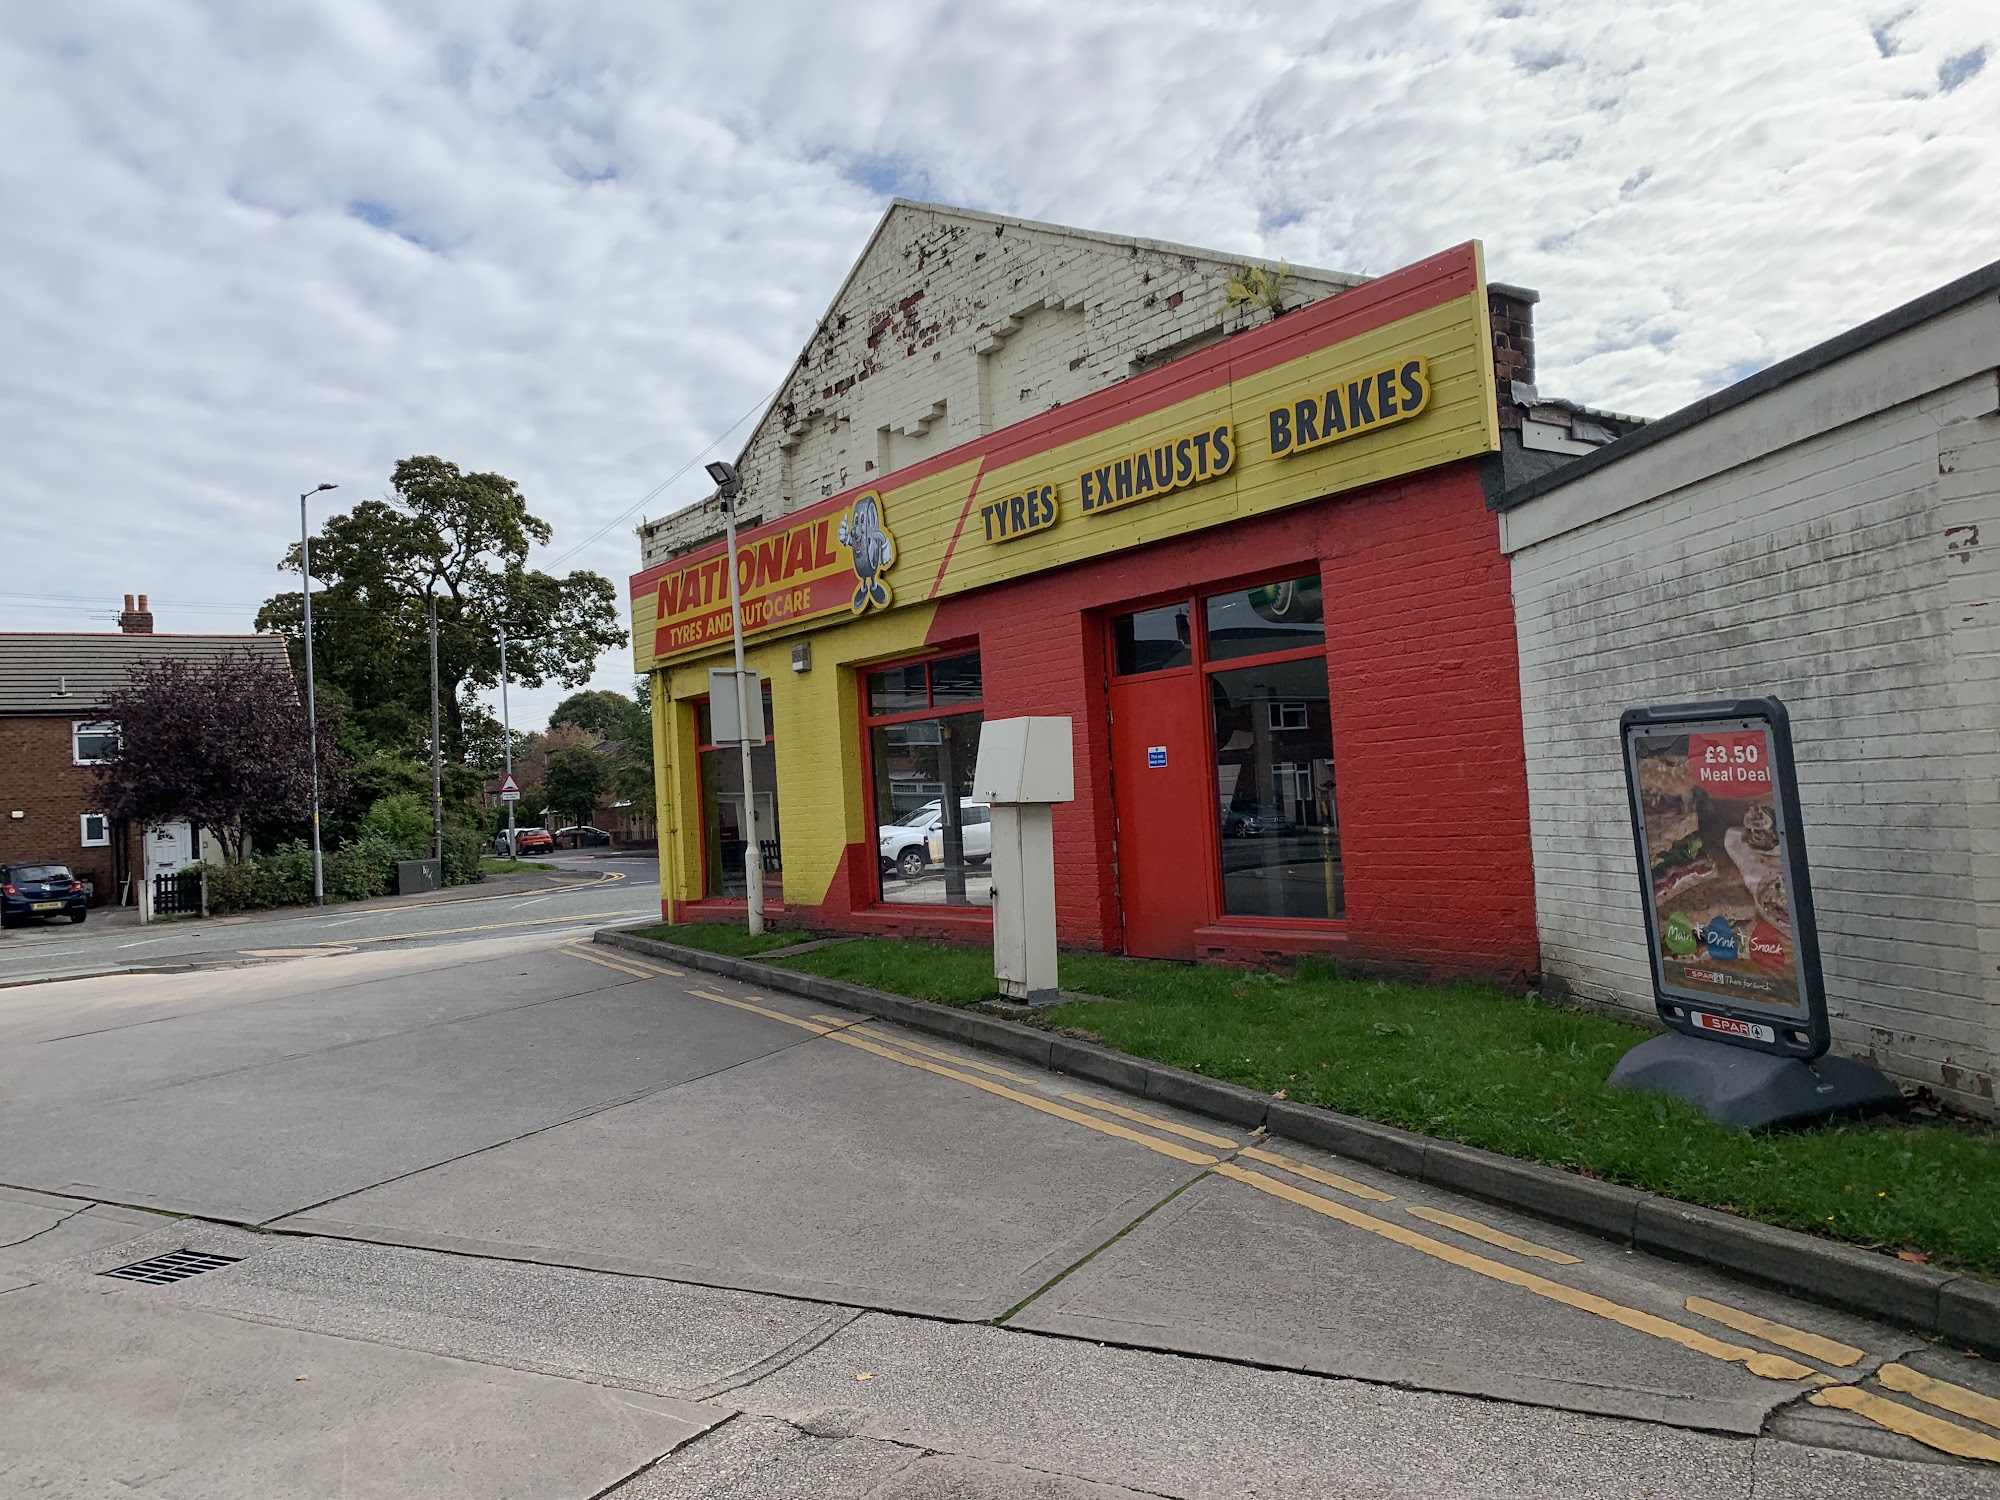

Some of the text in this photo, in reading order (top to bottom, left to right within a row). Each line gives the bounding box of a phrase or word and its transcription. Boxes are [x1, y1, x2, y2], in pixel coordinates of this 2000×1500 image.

[979, 361, 1423, 541] TYRES EXHAUSTS BRAKES
[657, 520, 836, 620] NATIONAL
[669, 620, 703, 648] TYRES
[706, 611, 733, 638] AND
[1705, 745, 1758, 763] £3.50
[1700, 766, 1771, 782] Meal Deal
[1667, 925, 1693, 942] Main
[1707, 931, 1736, 949] Drink
[1750, 937, 1783, 955] Snack
[1691, 970, 1715, 980] SPAR
[1711, 1018, 1750, 1034] SPAR
